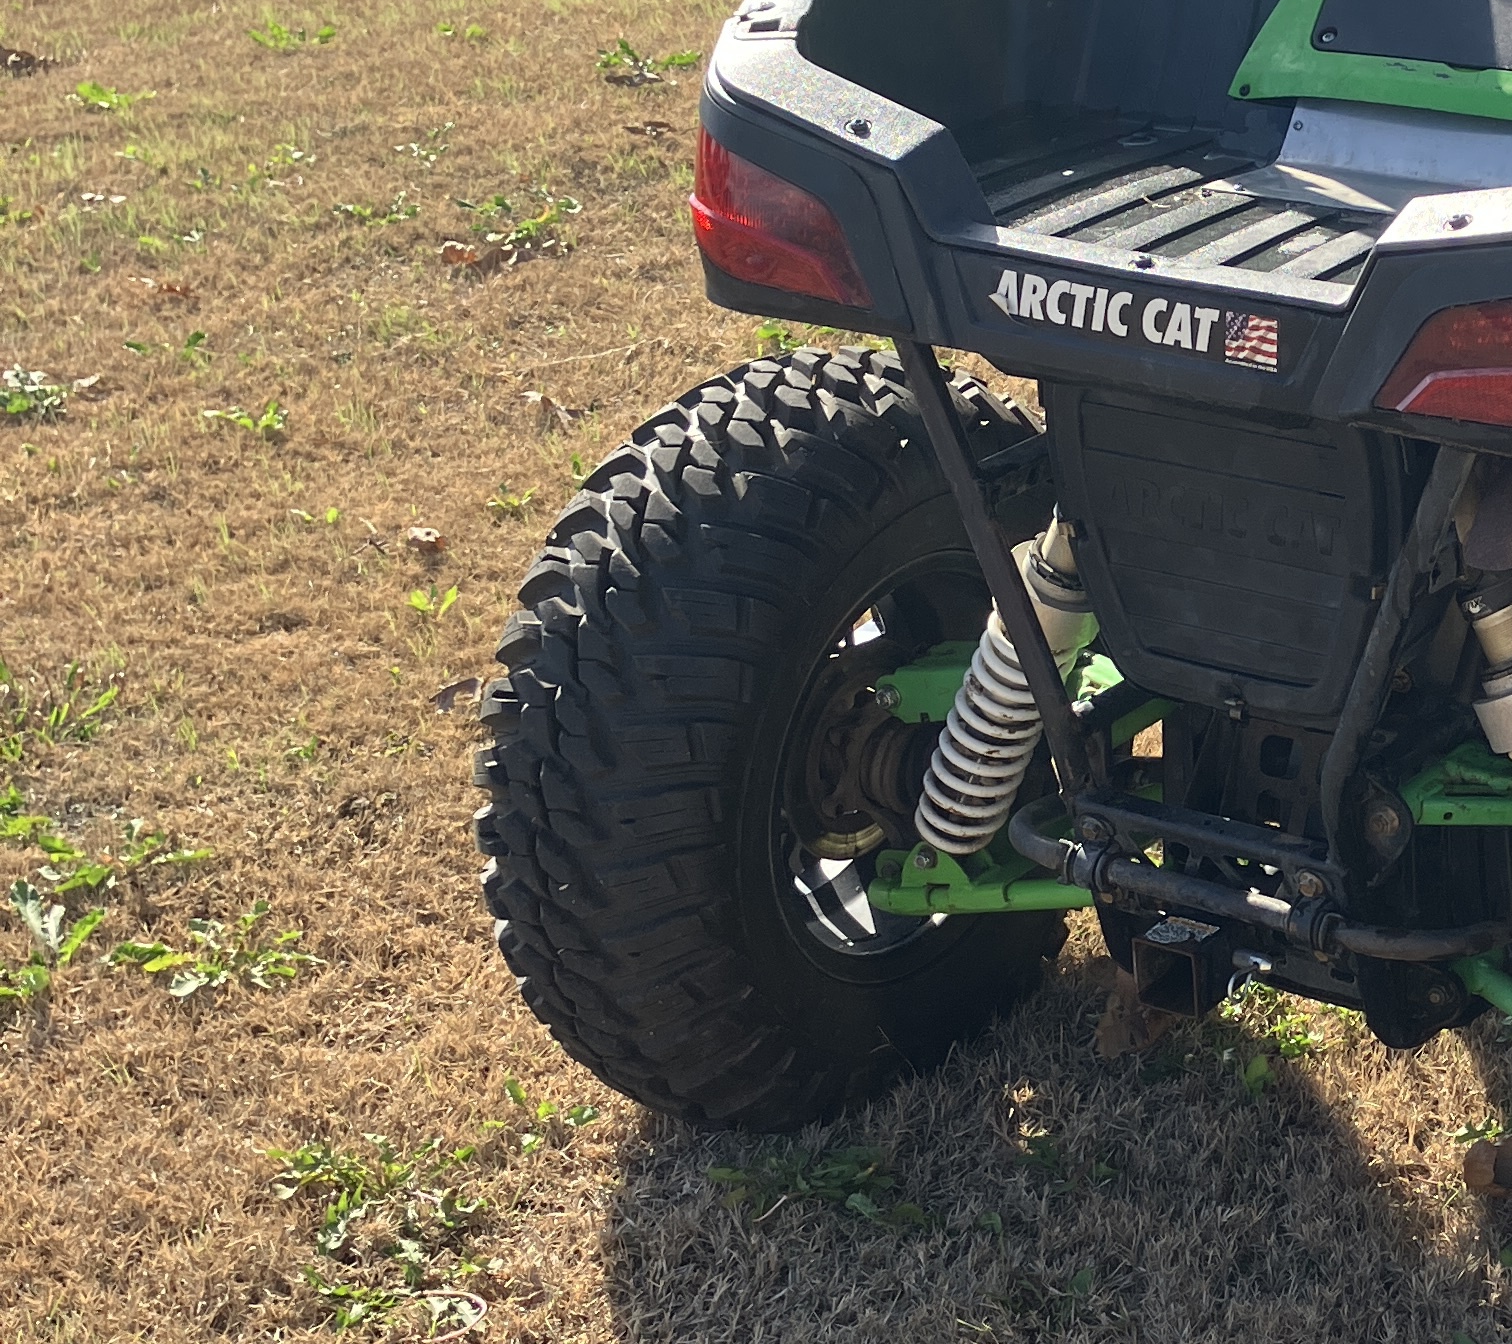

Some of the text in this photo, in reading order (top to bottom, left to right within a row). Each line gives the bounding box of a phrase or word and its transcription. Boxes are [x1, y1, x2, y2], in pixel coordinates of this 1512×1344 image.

[990, 269, 1220, 353] ARCTIC CAT
[1106, 472, 1343, 556] ARCTIC CAT
